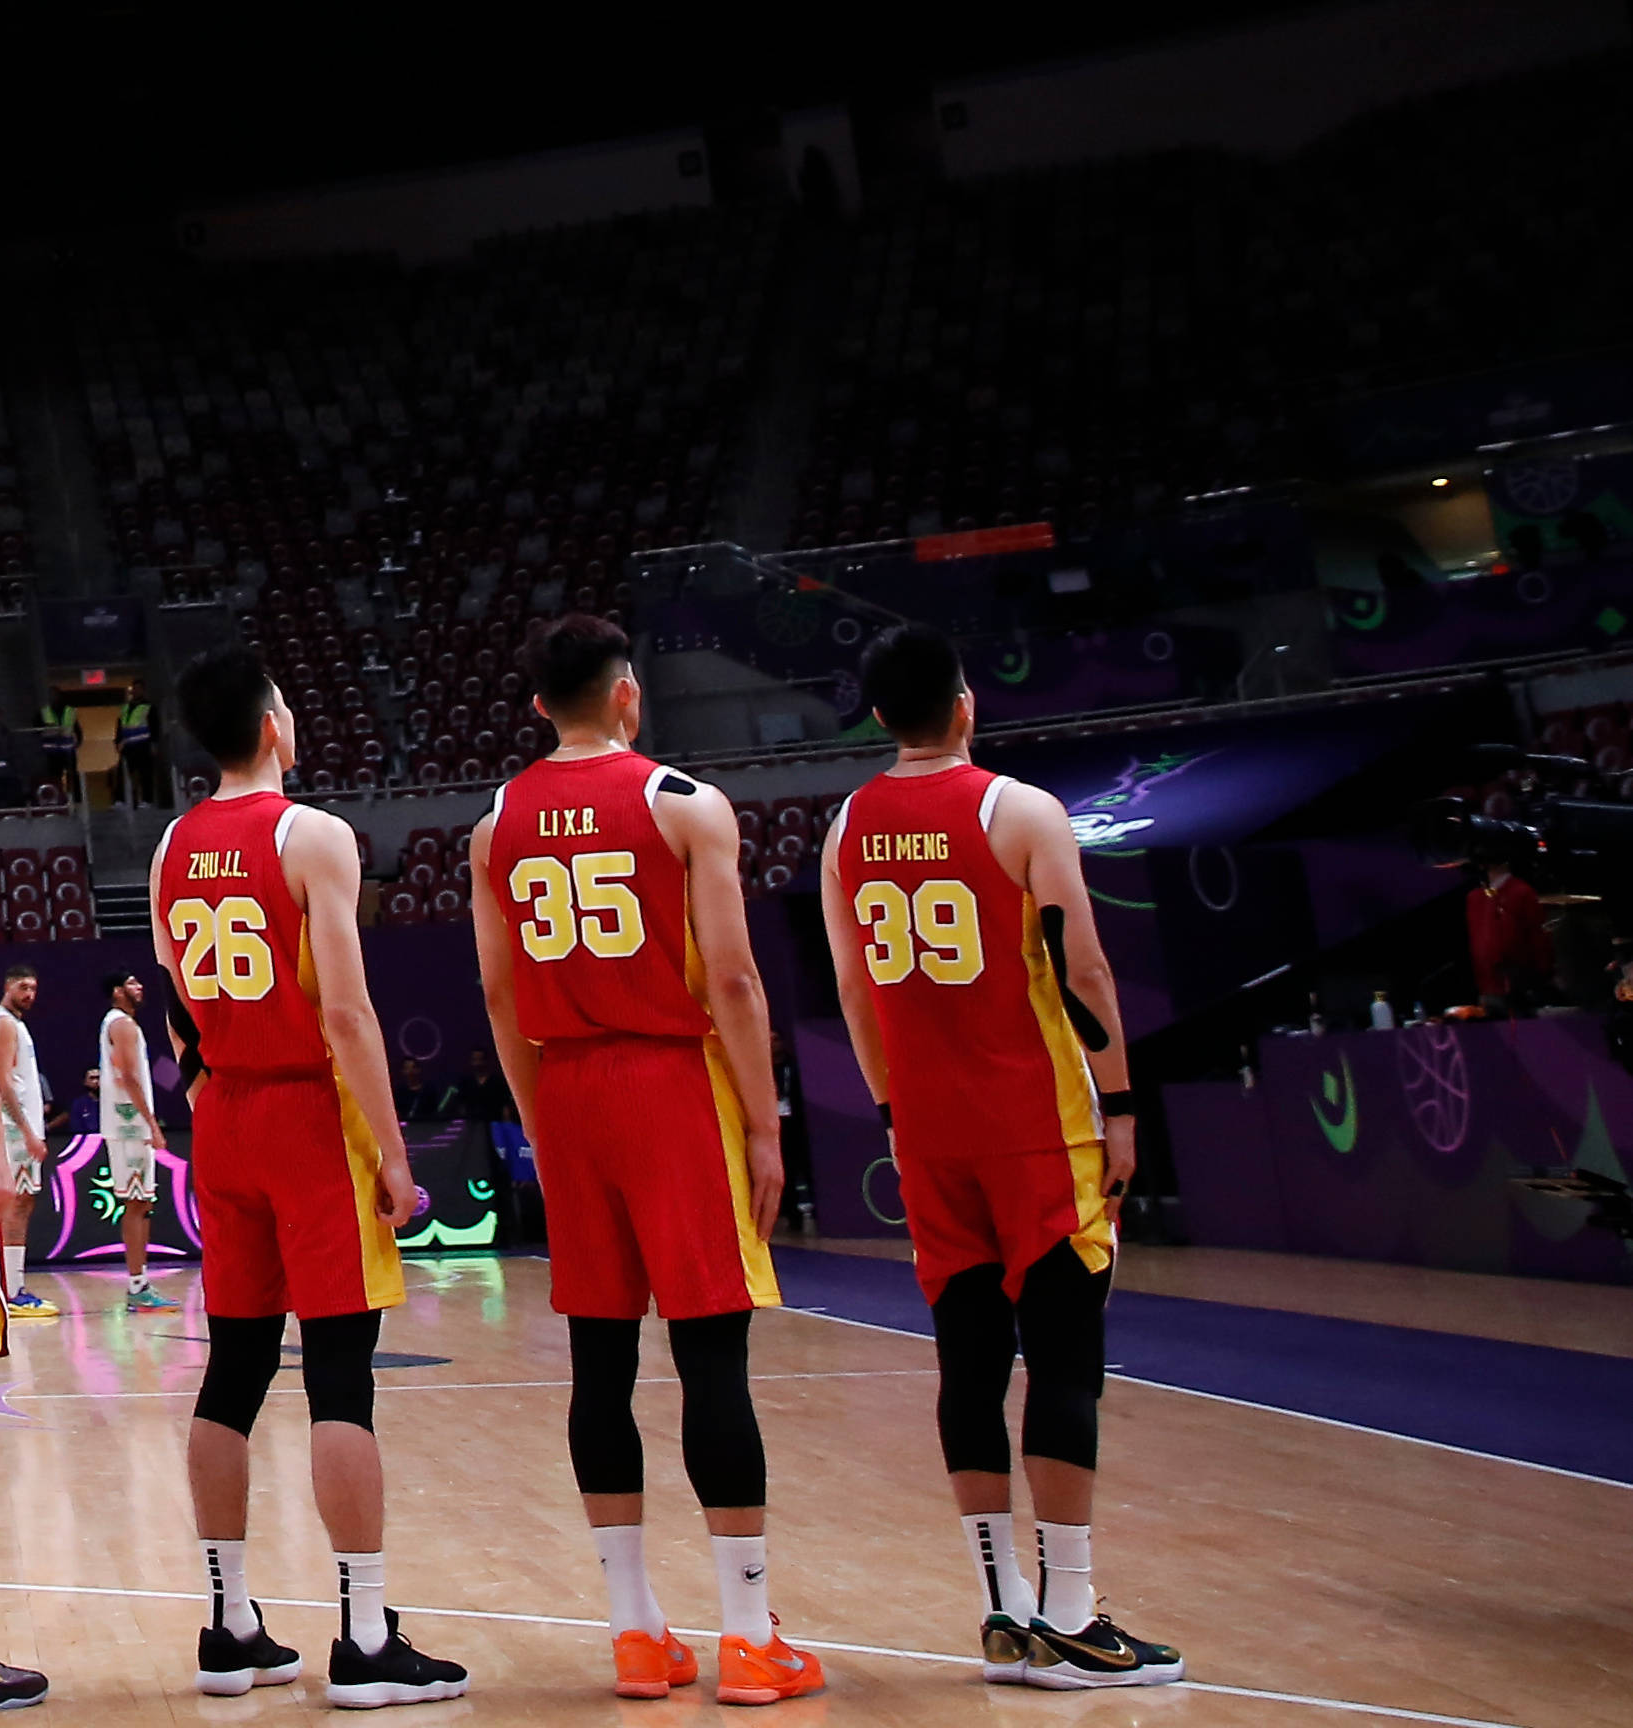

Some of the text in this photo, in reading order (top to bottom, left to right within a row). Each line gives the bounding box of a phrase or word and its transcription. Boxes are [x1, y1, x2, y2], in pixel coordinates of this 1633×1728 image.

[539, 807, 600, 837] LI X.B.
[862, 832, 949, 862] LEI MENG
[188, 850, 248, 879] ZHU J.L.
[509, 851, 646, 962] 35
[854, 880, 985, 985] 39
[167, 896, 275, 1001] 26
